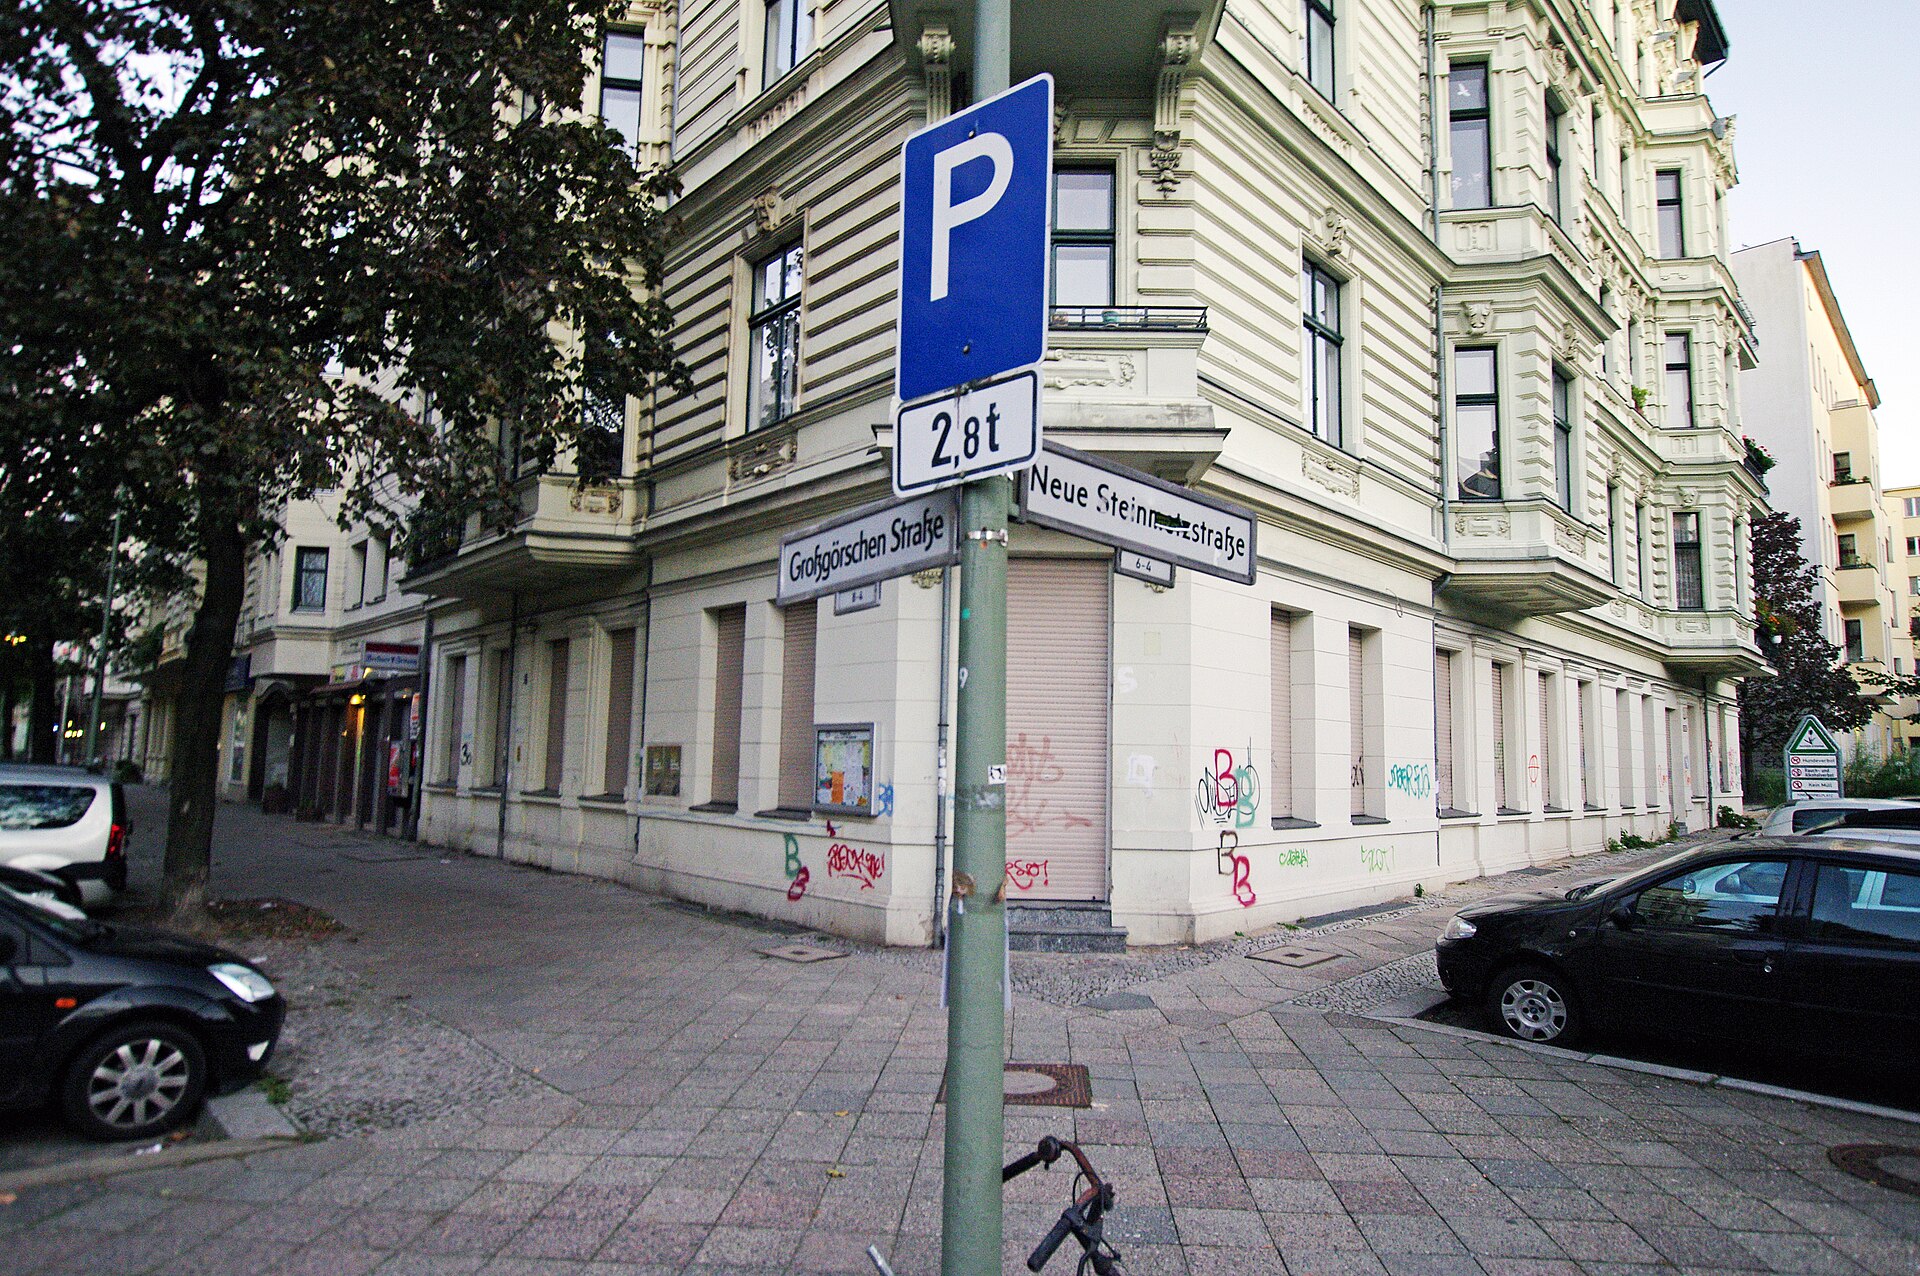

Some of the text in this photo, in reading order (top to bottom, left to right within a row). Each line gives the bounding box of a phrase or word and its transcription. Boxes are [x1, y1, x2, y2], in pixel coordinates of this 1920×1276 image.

[930, 132, 1014, 302] P
[1030, 463, 1088, 508] Neue
[789, 507, 944, 583] Großgörschen Straße
